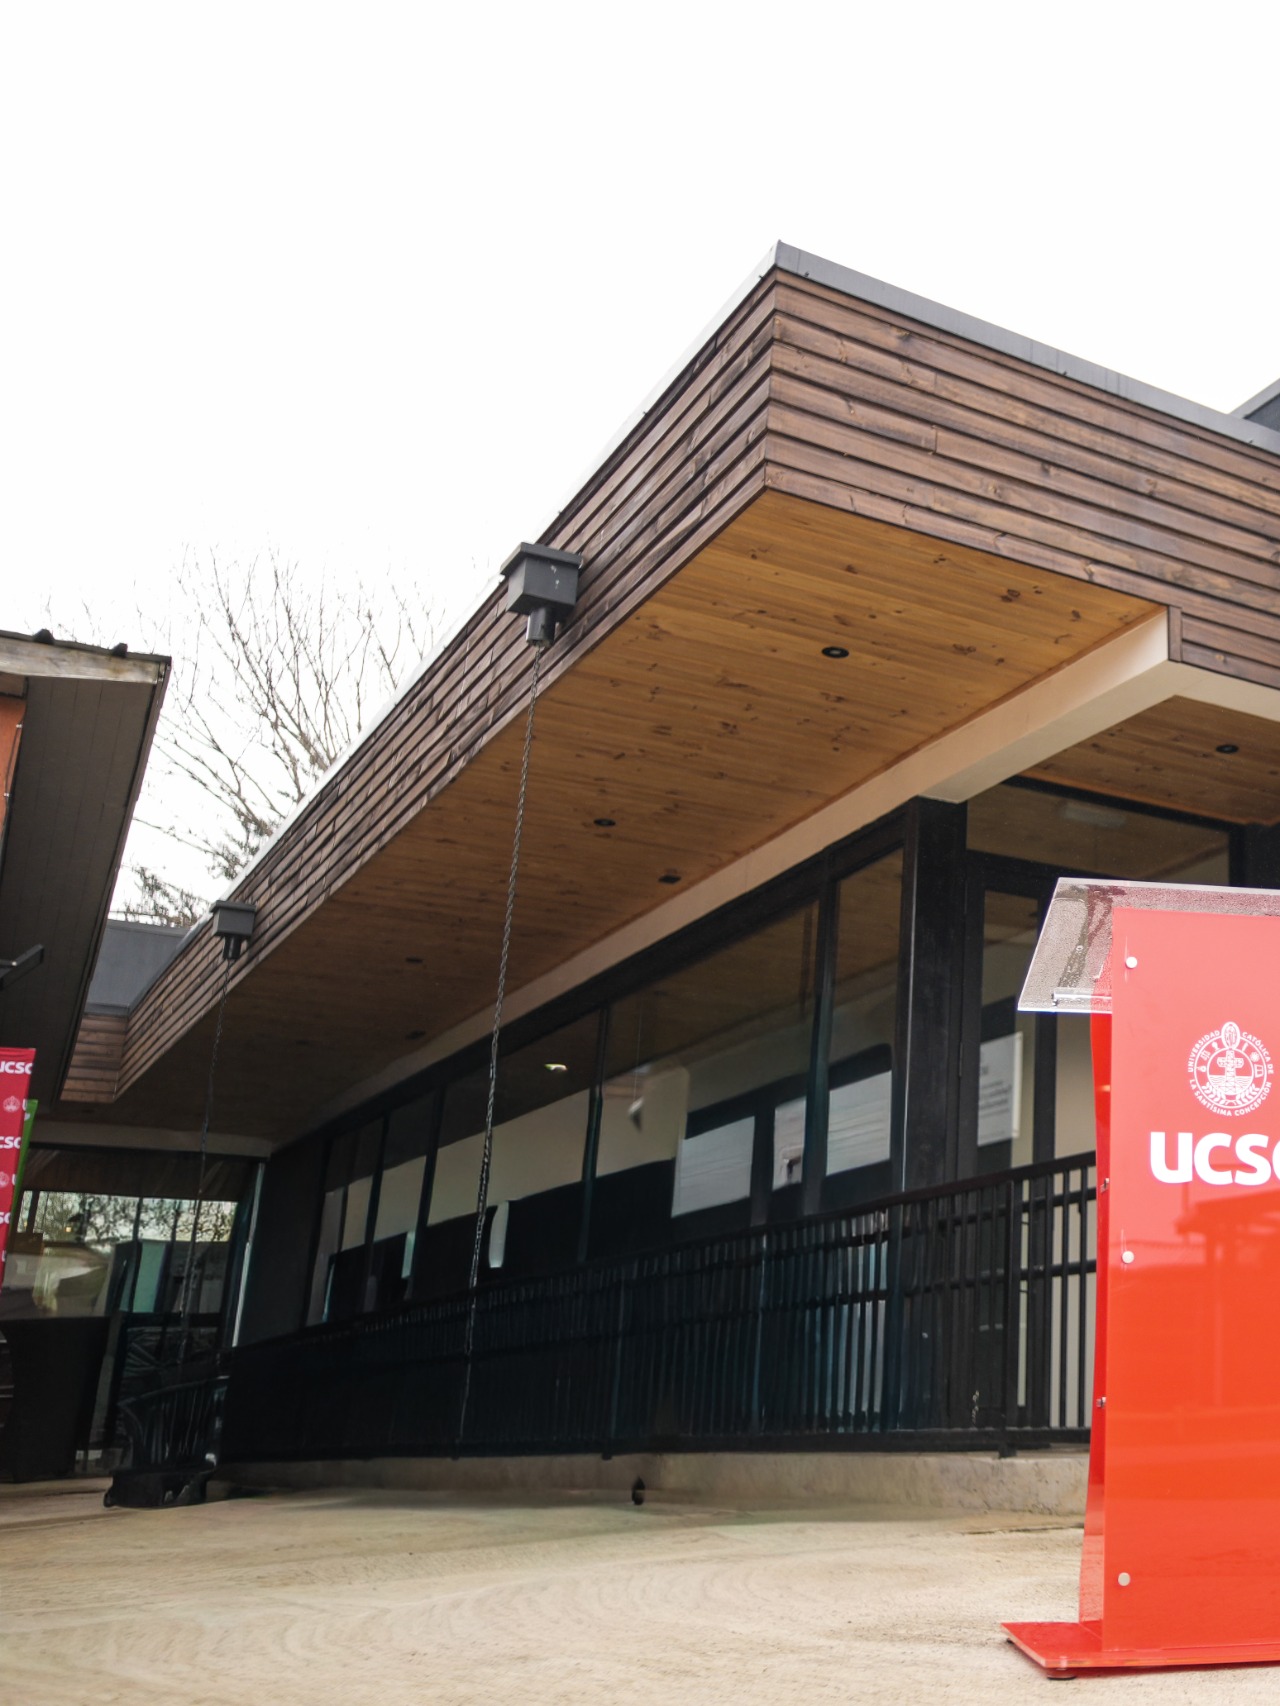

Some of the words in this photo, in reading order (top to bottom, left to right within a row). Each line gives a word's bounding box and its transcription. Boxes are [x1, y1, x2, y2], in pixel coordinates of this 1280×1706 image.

[1187, 1030, 1220, 1073] UNIVERSIDAD
[1242, 1031, 1271, 1063] CATÓLICA
[1267, 1063, 1274, 1075] DE
[1189, 1079, 1197, 1090] LA
[1194, 1090, 1232, 1117] SANTÍSIMA
